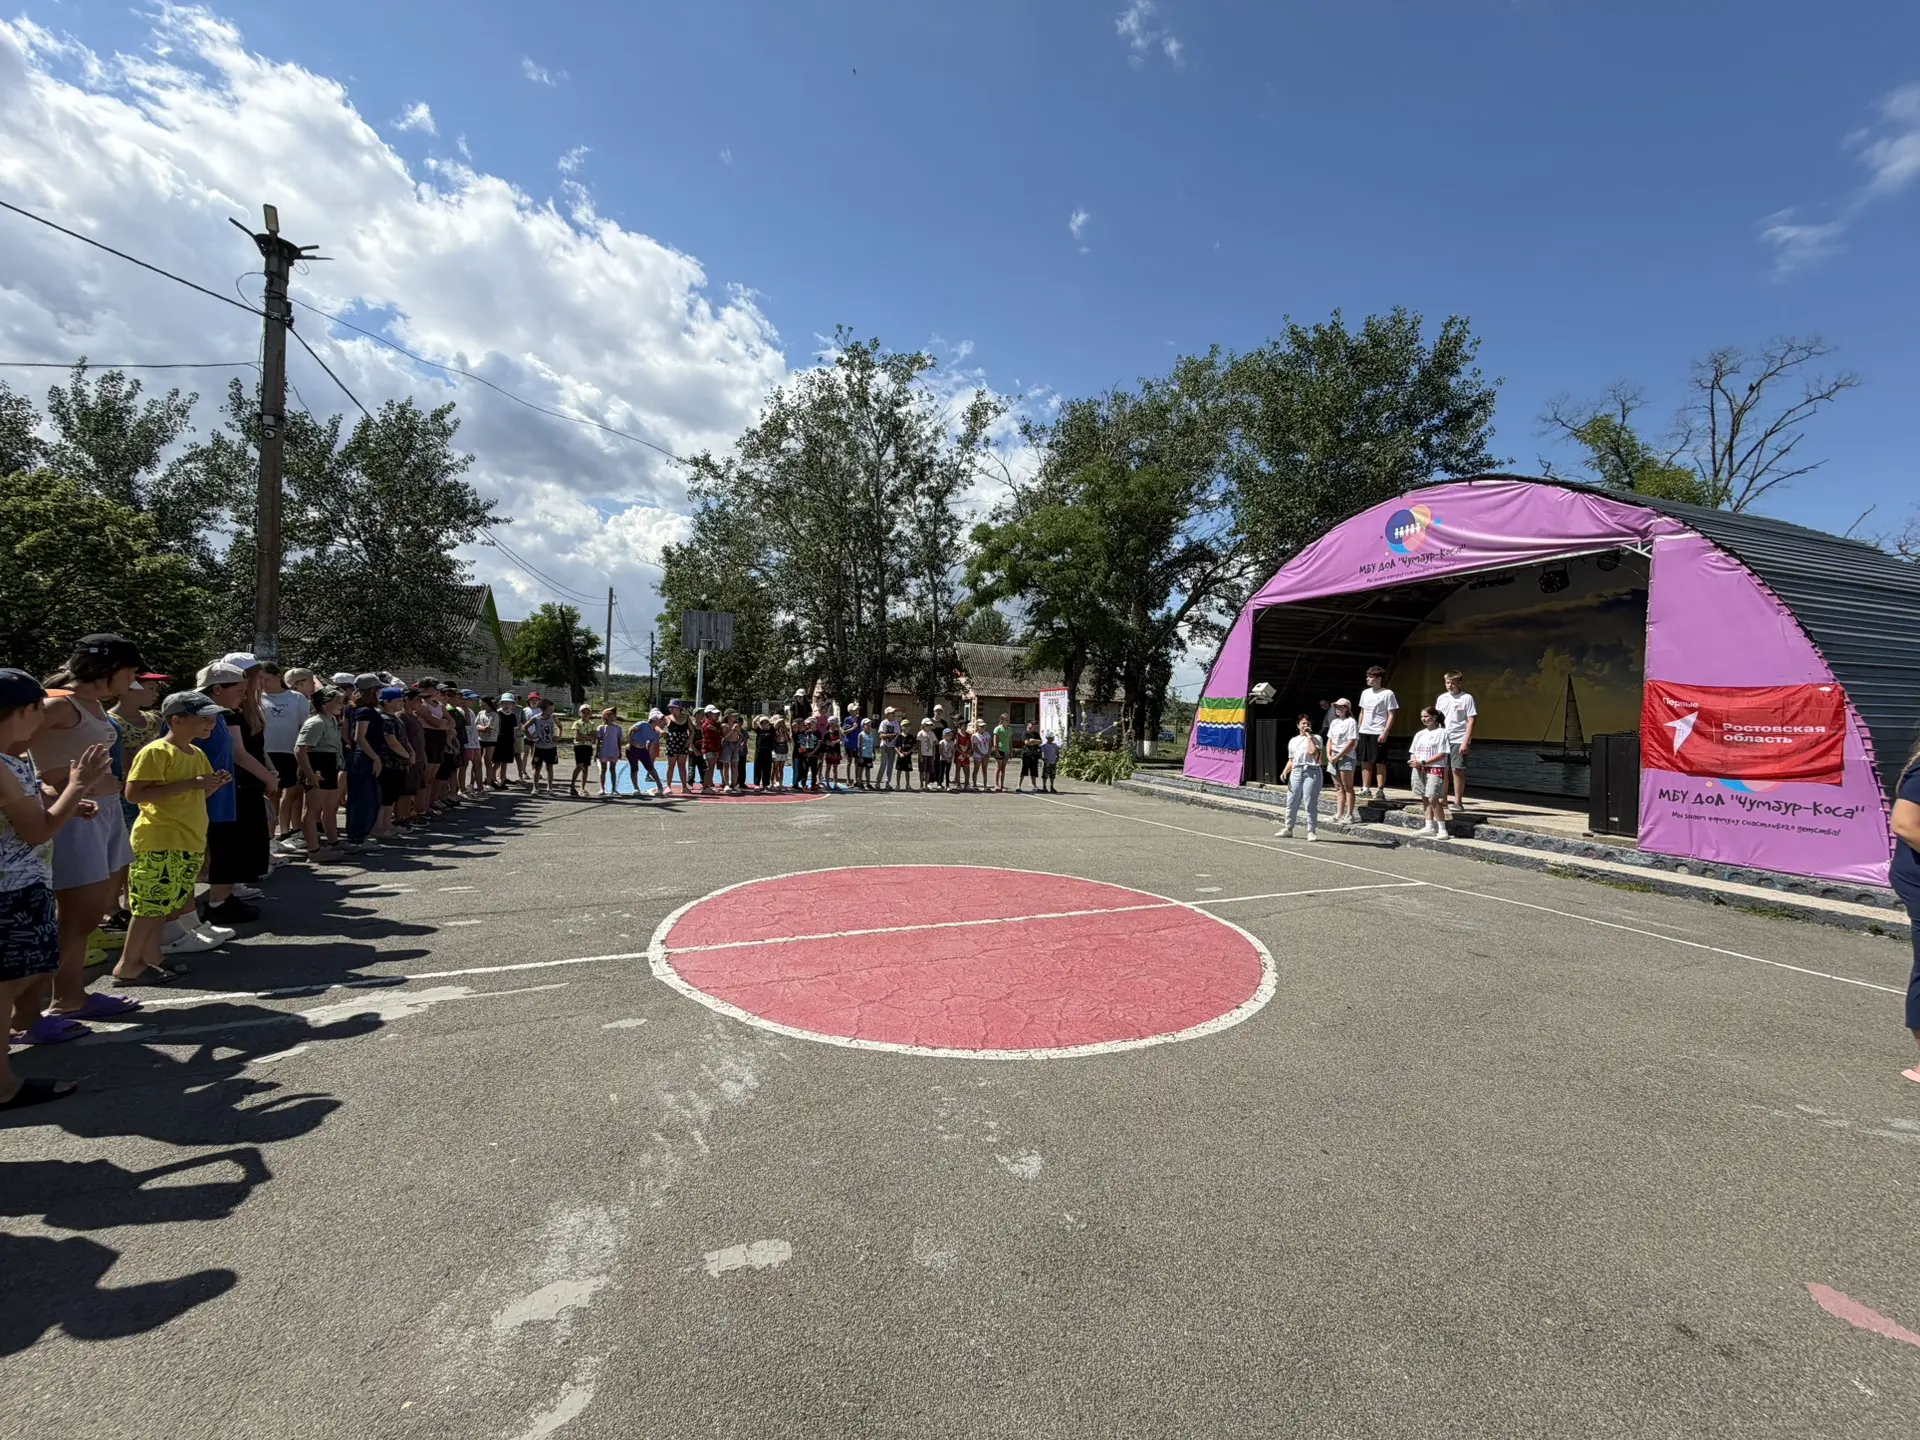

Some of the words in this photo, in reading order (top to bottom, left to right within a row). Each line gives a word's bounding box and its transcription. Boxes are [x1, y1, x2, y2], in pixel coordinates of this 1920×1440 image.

[1359, 563, 1377, 574] МБУ
[1662, 697, 1699, 708] Первые
[1722, 722, 1826, 733] Ростовская
[1723, 733, 1793, 744] область
[1658, 788, 1689, 804] МБУ
[1691, 792, 1726, 806] ДОЛ
[1671, 811, 1683, 819] Мы
[1684, 813, 1706, 821] знаем
[1707, 815, 1740, 826] формулу
[1741, 819, 1796, 831] счастливого
[1796, 825, 1841, 837] детства!
